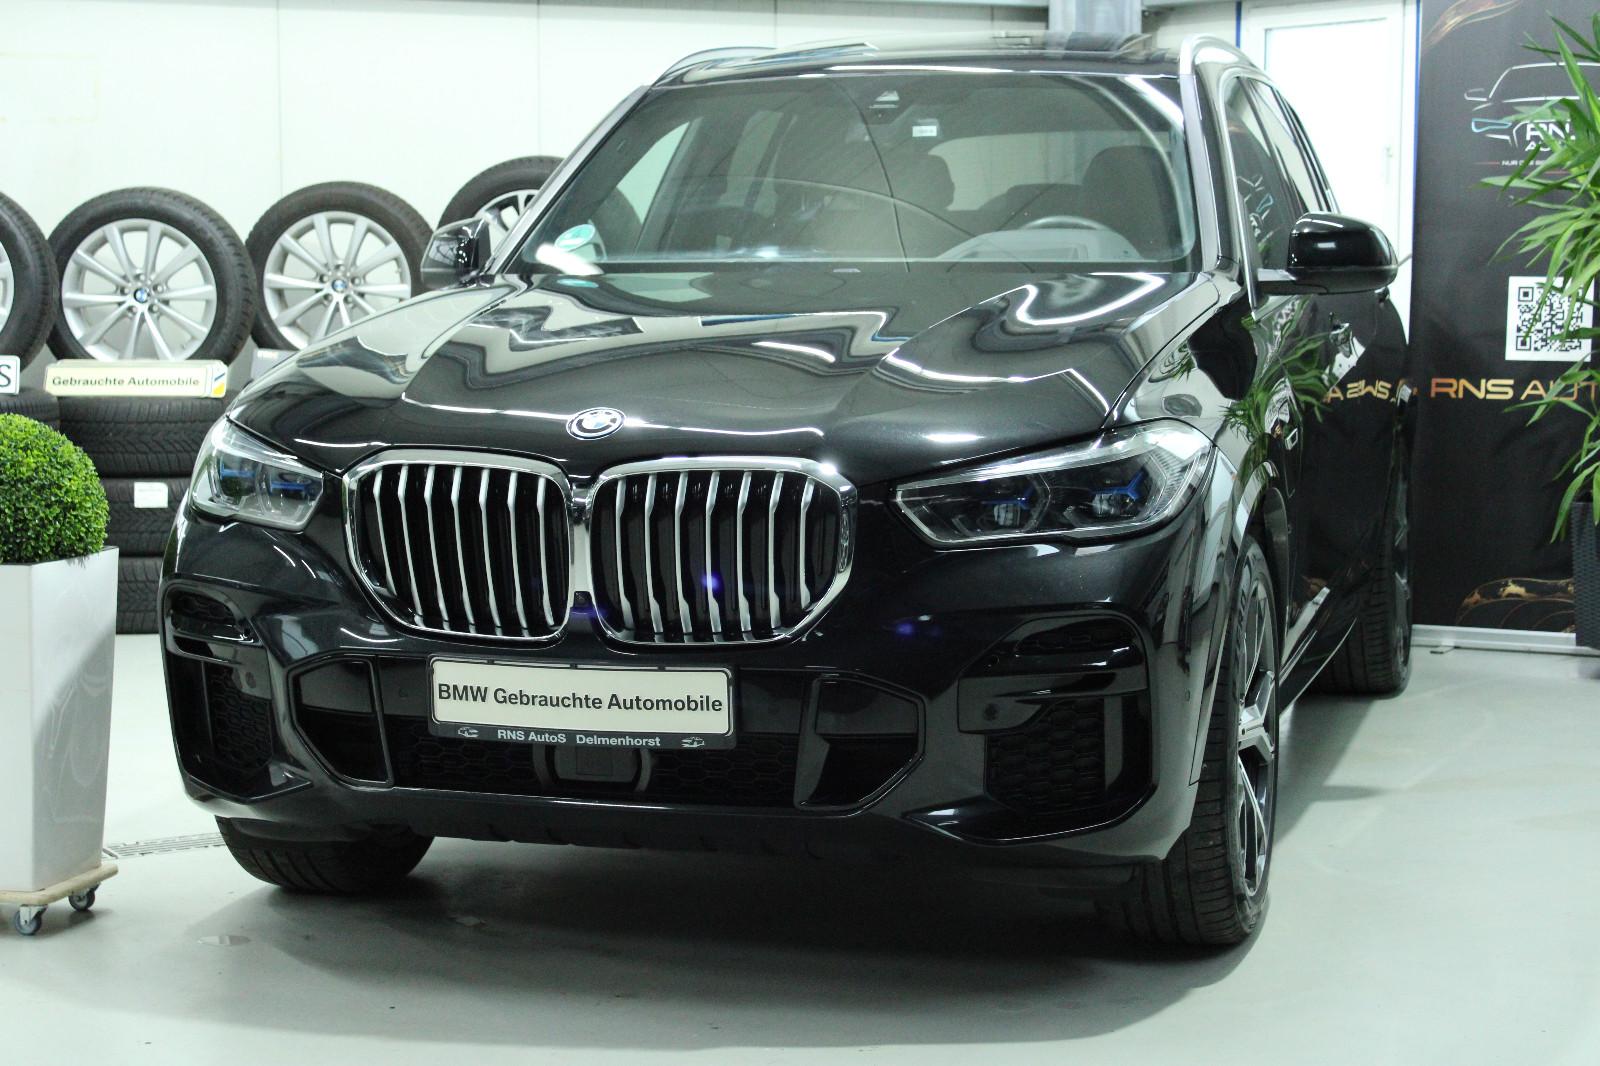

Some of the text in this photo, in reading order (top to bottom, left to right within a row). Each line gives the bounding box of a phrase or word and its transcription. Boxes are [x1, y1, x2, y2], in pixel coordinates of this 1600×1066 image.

[1526, 122, 1576, 141] RN
[52, 376, 200, 387] Gebrauchte Automobile
[1430, 377, 1515, 400] RNS
[437, 683, 723, 712] BMW Gebrauchte Automobile
[497, 729, 525, 741] RNS
[576, 734, 661, 747] Delmenhorst
